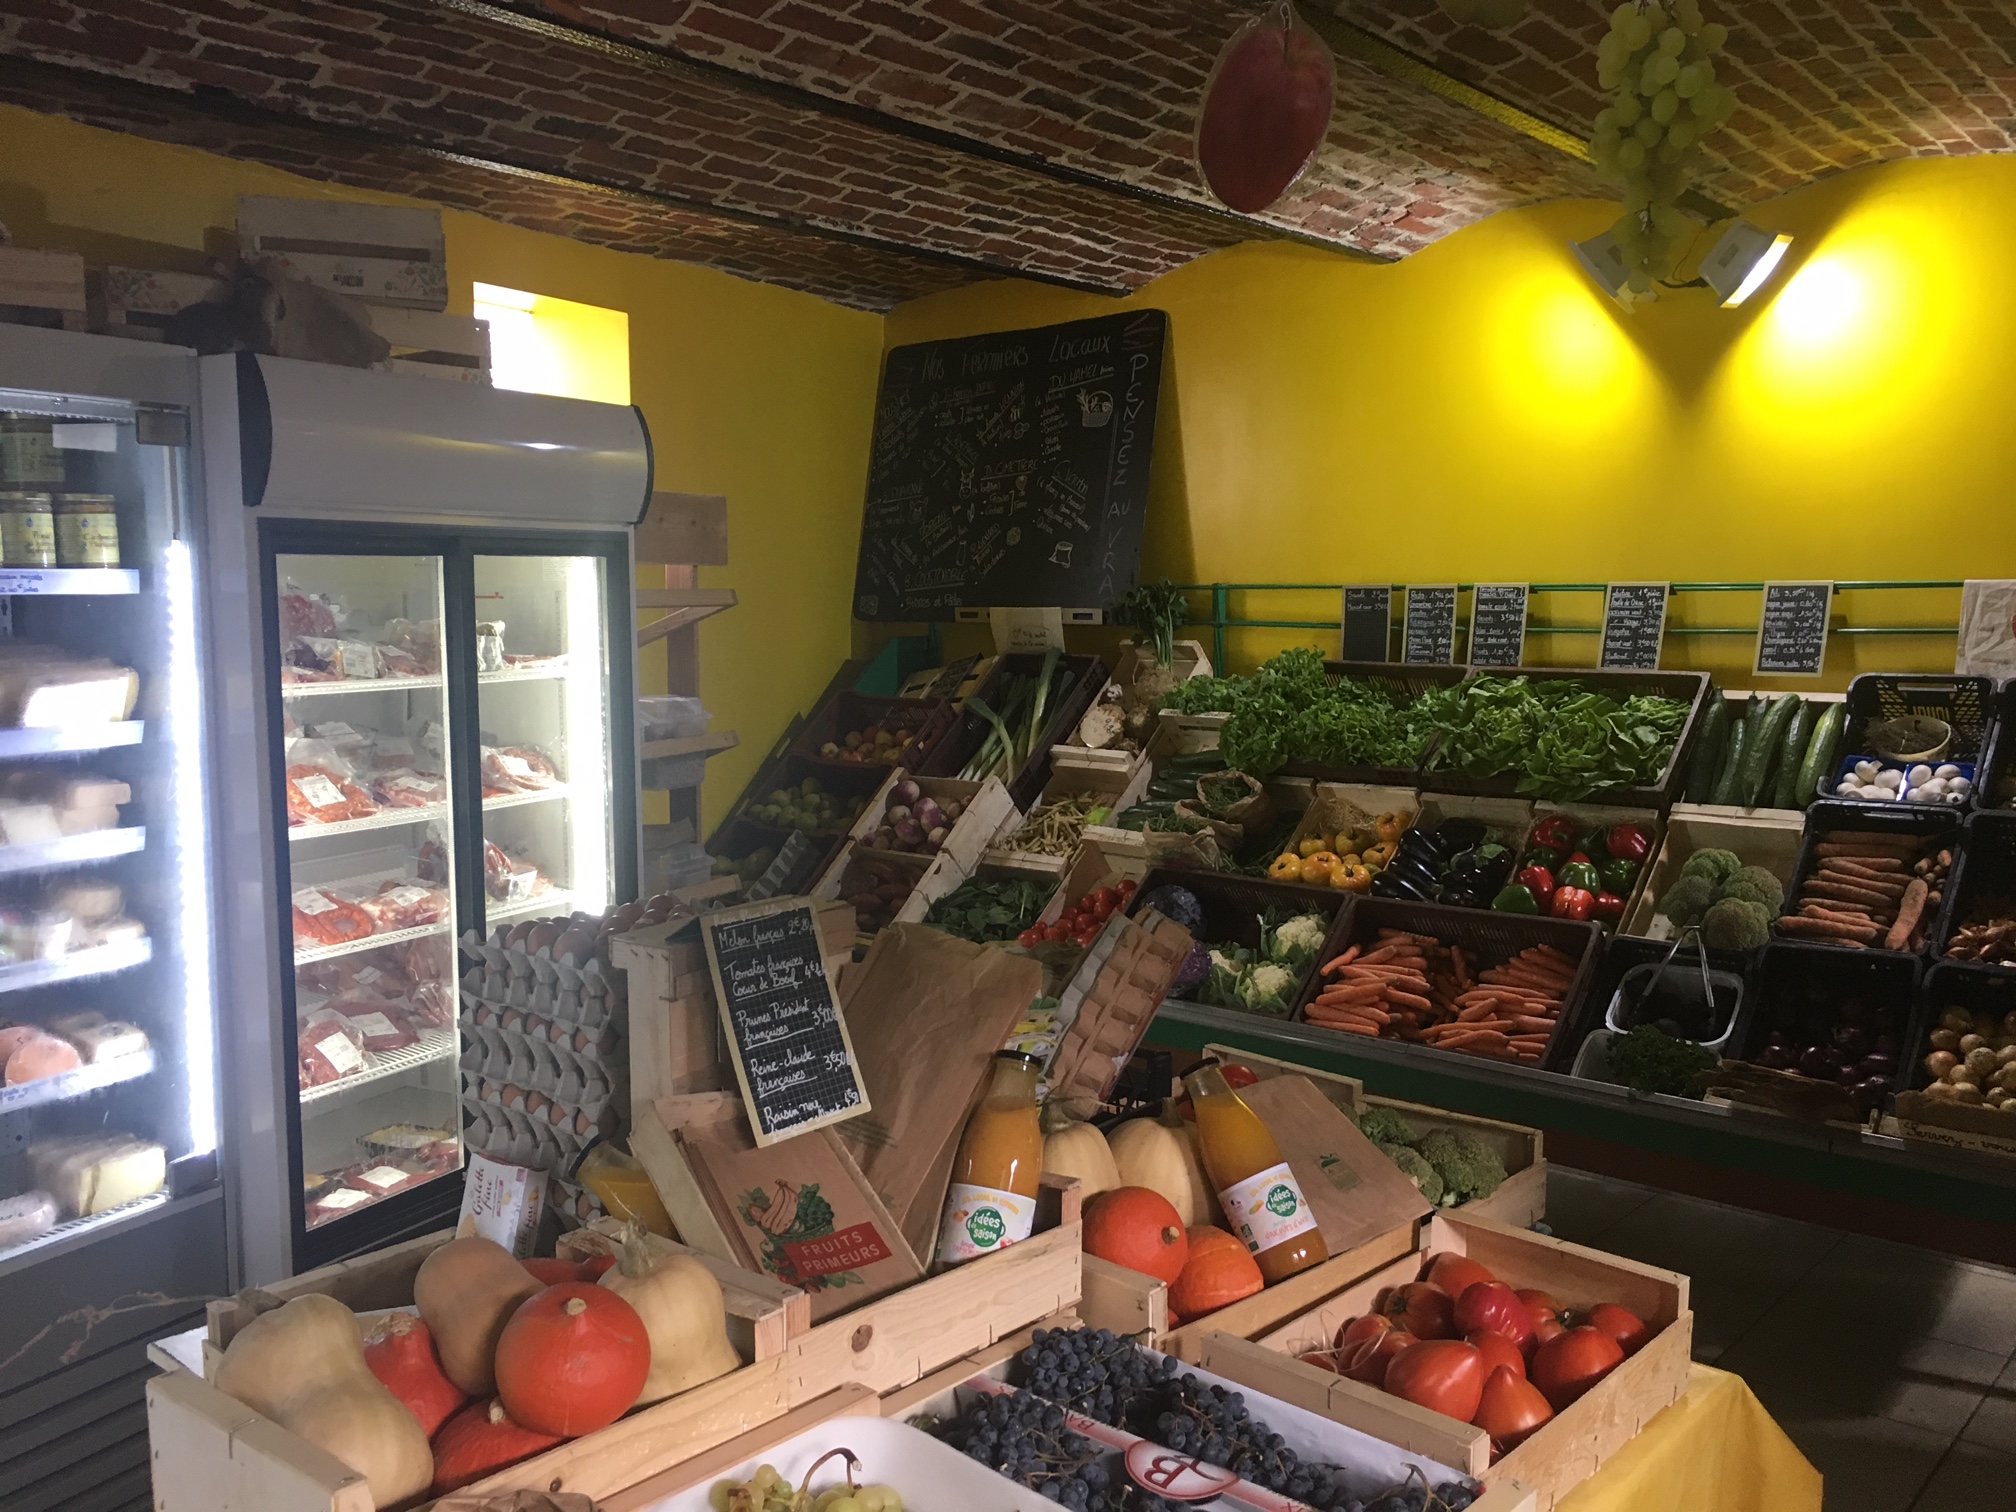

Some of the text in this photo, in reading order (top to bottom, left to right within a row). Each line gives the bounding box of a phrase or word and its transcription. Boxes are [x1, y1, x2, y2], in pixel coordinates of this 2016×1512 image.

[1048, 334, 1112, 362] Locaux
[719, 929, 750, 949] Melon
[724, 958, 766, 980] Tomates
[759, 977, 768, 990] de
[736, 1010, 771, 1027] Prunes
[743, 1024, 789, 1046] françaises
[756, 1070, 806, 1097] françaises
[763, 1103, 799, 1125] Raisin
[1269, 1189, 1291, 1203] idées
[1276, 1200, 1296, 1213] saison
[974, 1212, 1000, 1228] idées
[801, 1231, 863, 1257] FRUITS
[973, 1228, 997, 1240] saison
[803, 1244, 880, 1272] PRIMEURS
